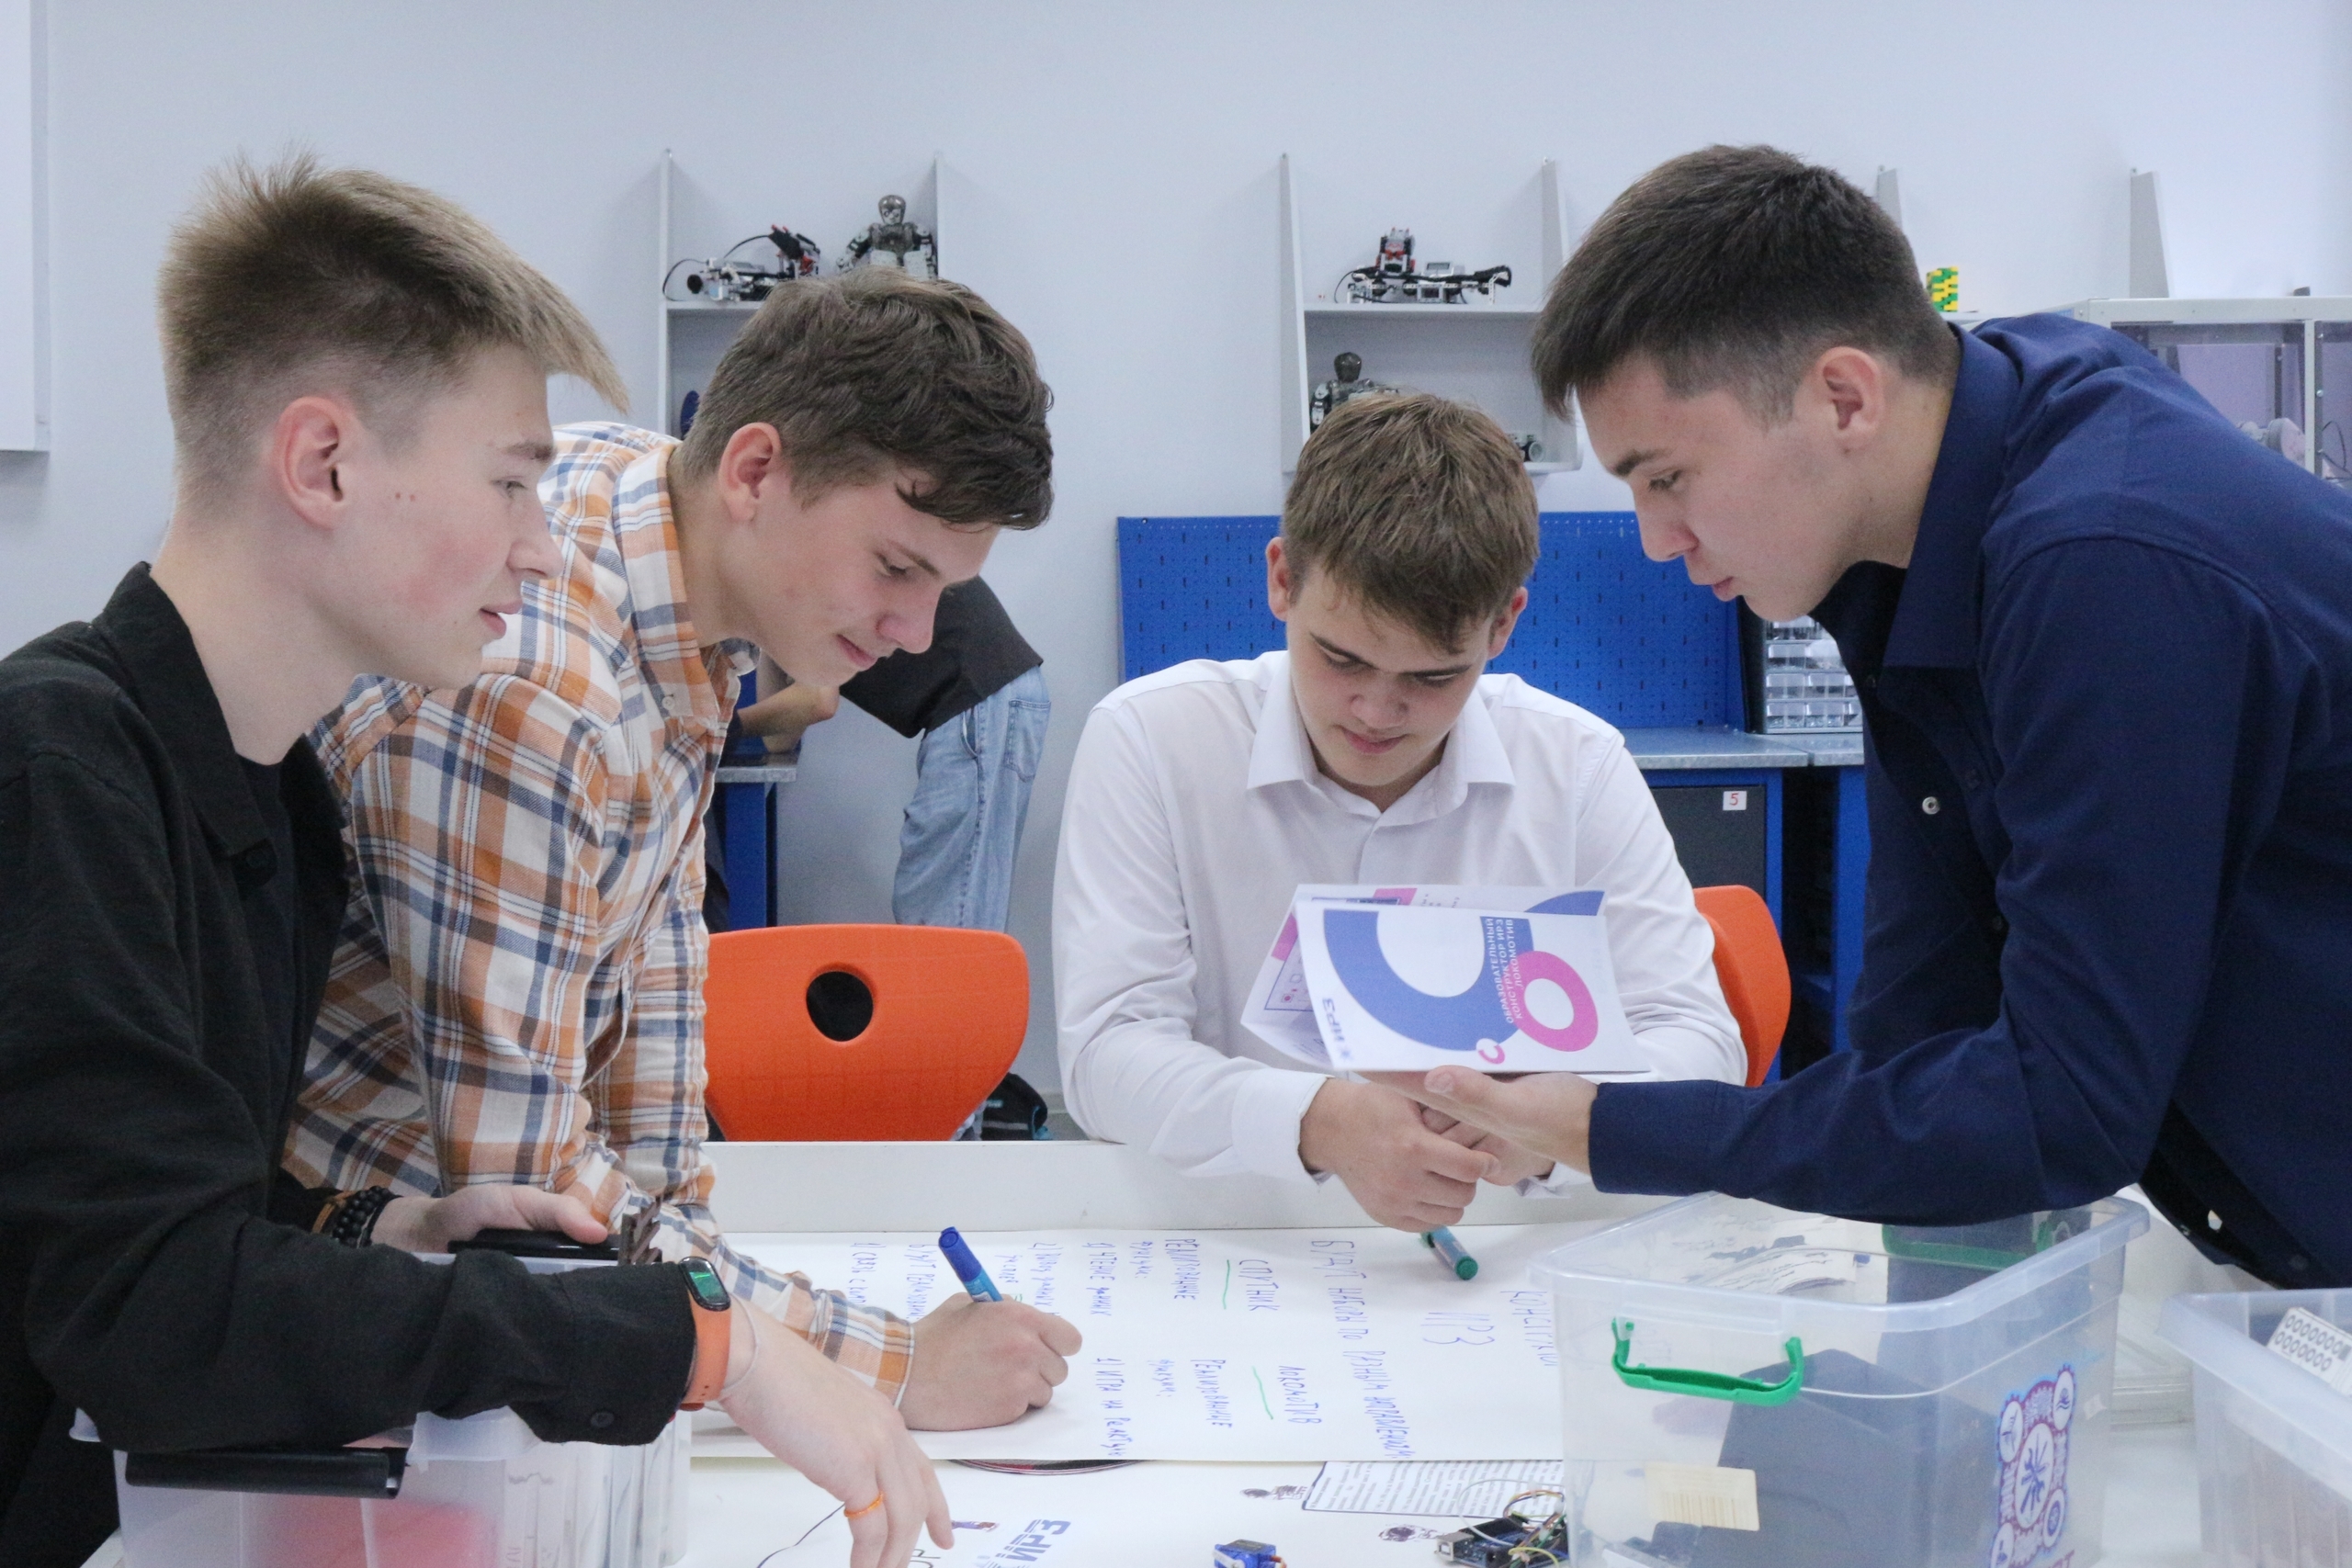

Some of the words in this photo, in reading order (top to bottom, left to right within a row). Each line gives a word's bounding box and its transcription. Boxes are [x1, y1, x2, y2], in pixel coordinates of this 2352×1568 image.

[1730, 793, 1739, 806] 5
[1495, 919, 1505, 940] ИРЗ
[1485, 918, 1514, 1024] ОБРАЗОВАТЕЛЬНЫЙ
[1505, 919, 1523, 987] ЛОКОМОТИВ
[1497, 943, 1523, 1020] КОНСТРУКТОР
[1089, 1251, 1117, 1280] ЧТЕНИЕ
[1238, 1259, 1281, 1313] СПУТНИК
[1328, 1287, 1368, 1323] НАБОРЫ
[1420, 1310, 1496, 1346] ИРЗ
[1095, 1371, 1125, 1392] ИГРА
[1341, 1350, 1393, 1391] РАЗНЫМ
[1277, 1365, 1323, 1426] ЛОКОМОТИВ
[995, 1518, 1072, 1562] ИРЗ
